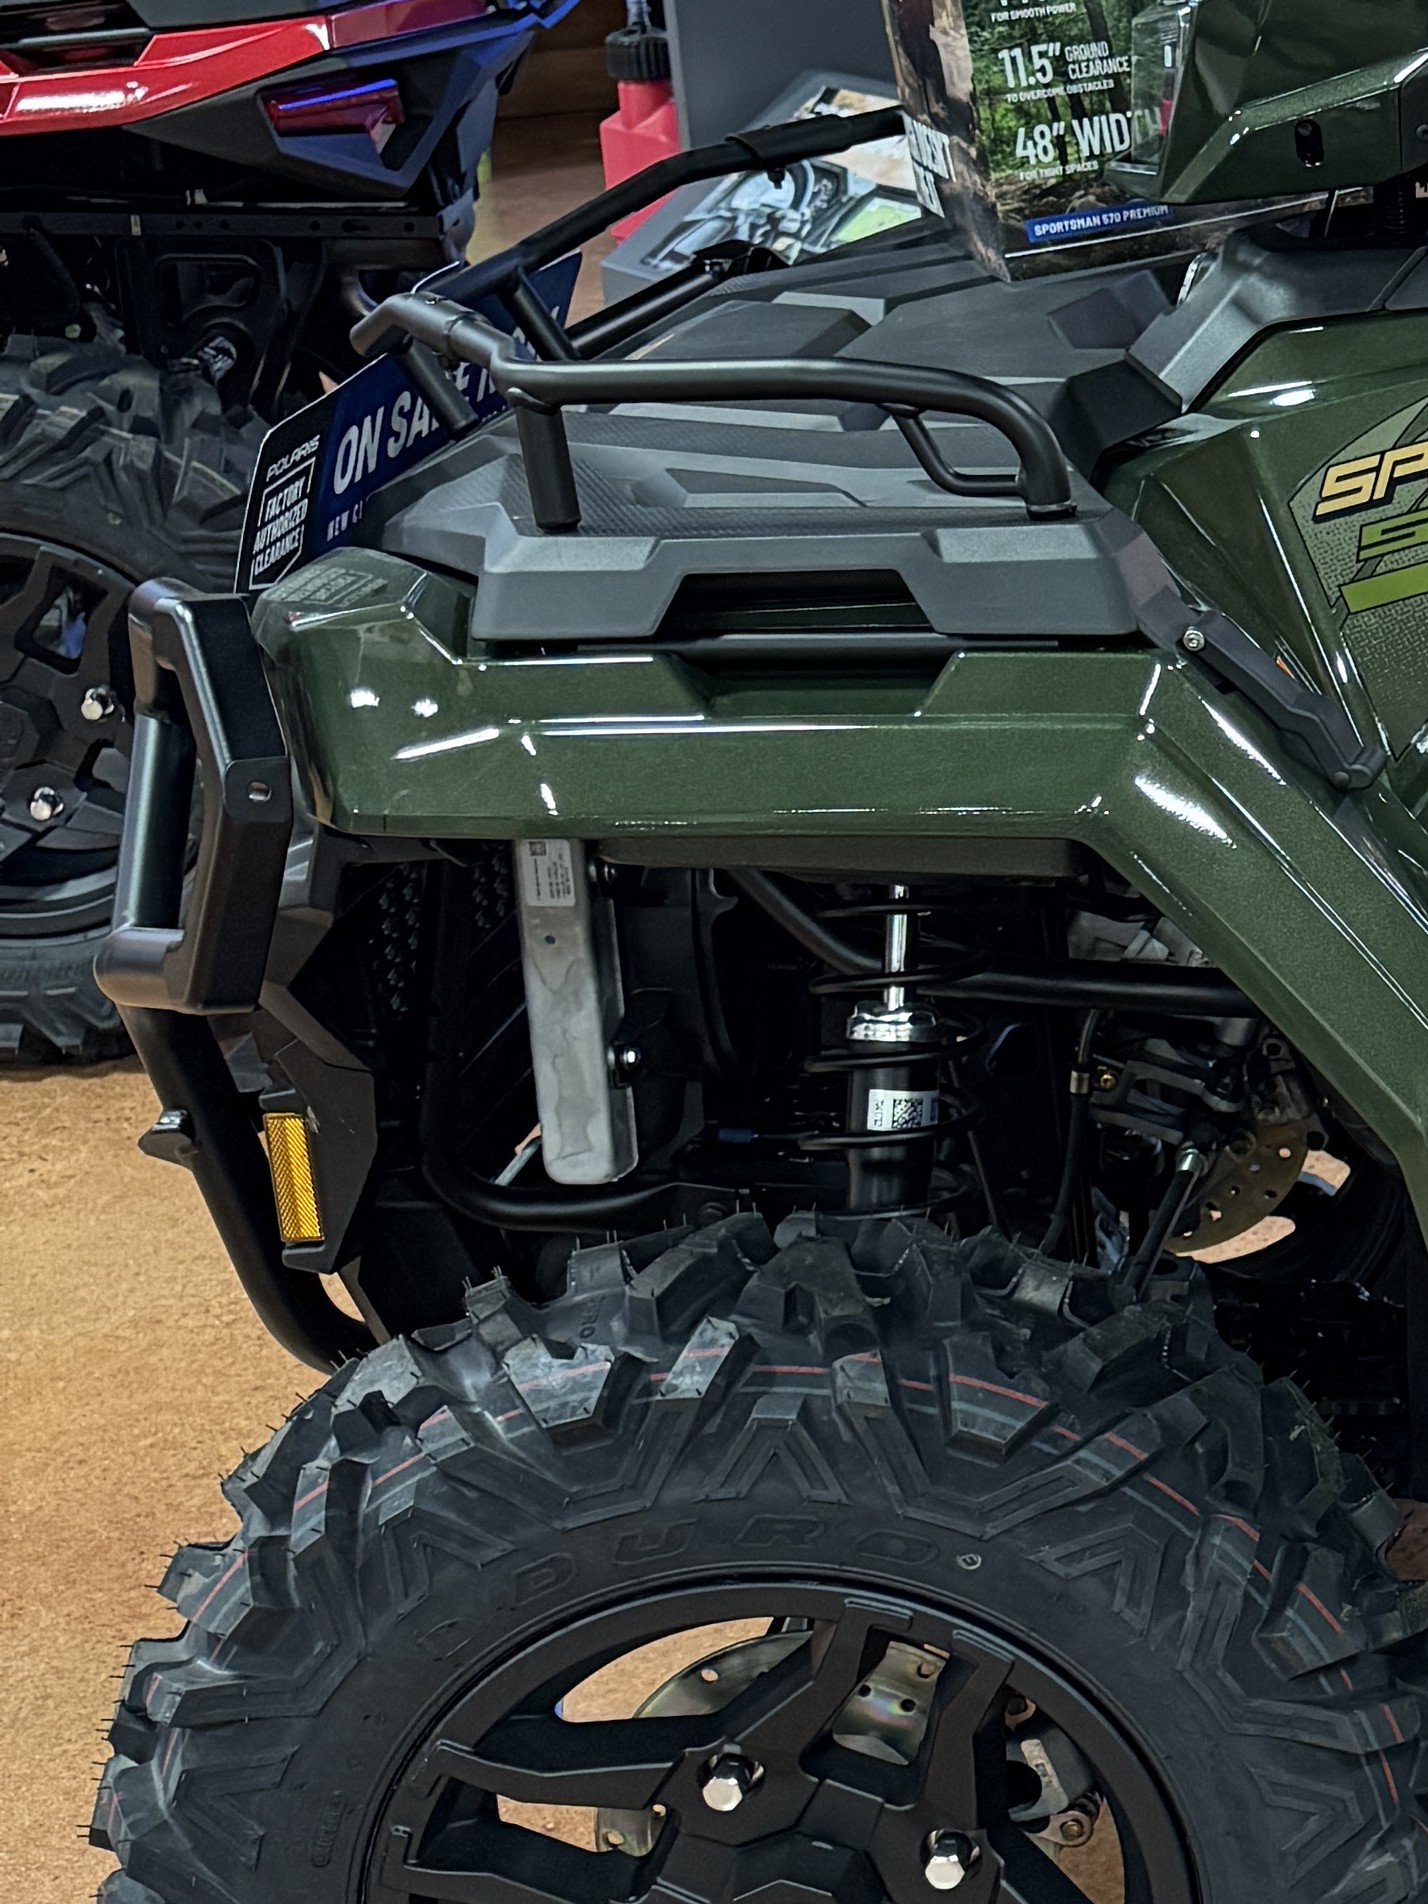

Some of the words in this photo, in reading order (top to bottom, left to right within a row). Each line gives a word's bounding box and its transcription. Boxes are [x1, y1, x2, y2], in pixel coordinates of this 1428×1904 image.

[991, 10, 1010, 23] FOR
[1010, 7, 1046, 21] SMOOTH
[1046, 2, 1077, 16] POWER
[1064, 41, 1109, 62] GROUND
[1067, 56, 1131, 80] CLEARANCE
[1015, 121, 1066, 165] 48"
[1034, 215, 1101, 237] SPORTSMAN
[1102, 212, 1122, 225] 570
[1122, 205, 1169, 222] PREMIUM
[265, 434, 321, 483] POLARIS
[334, 406, 384, 496] ON
[264, 475, 306, 522] FACTORY
[253, 497, 309, 555] AUTHORIZED
[253, 530, 300, 576] CLEARANCE
